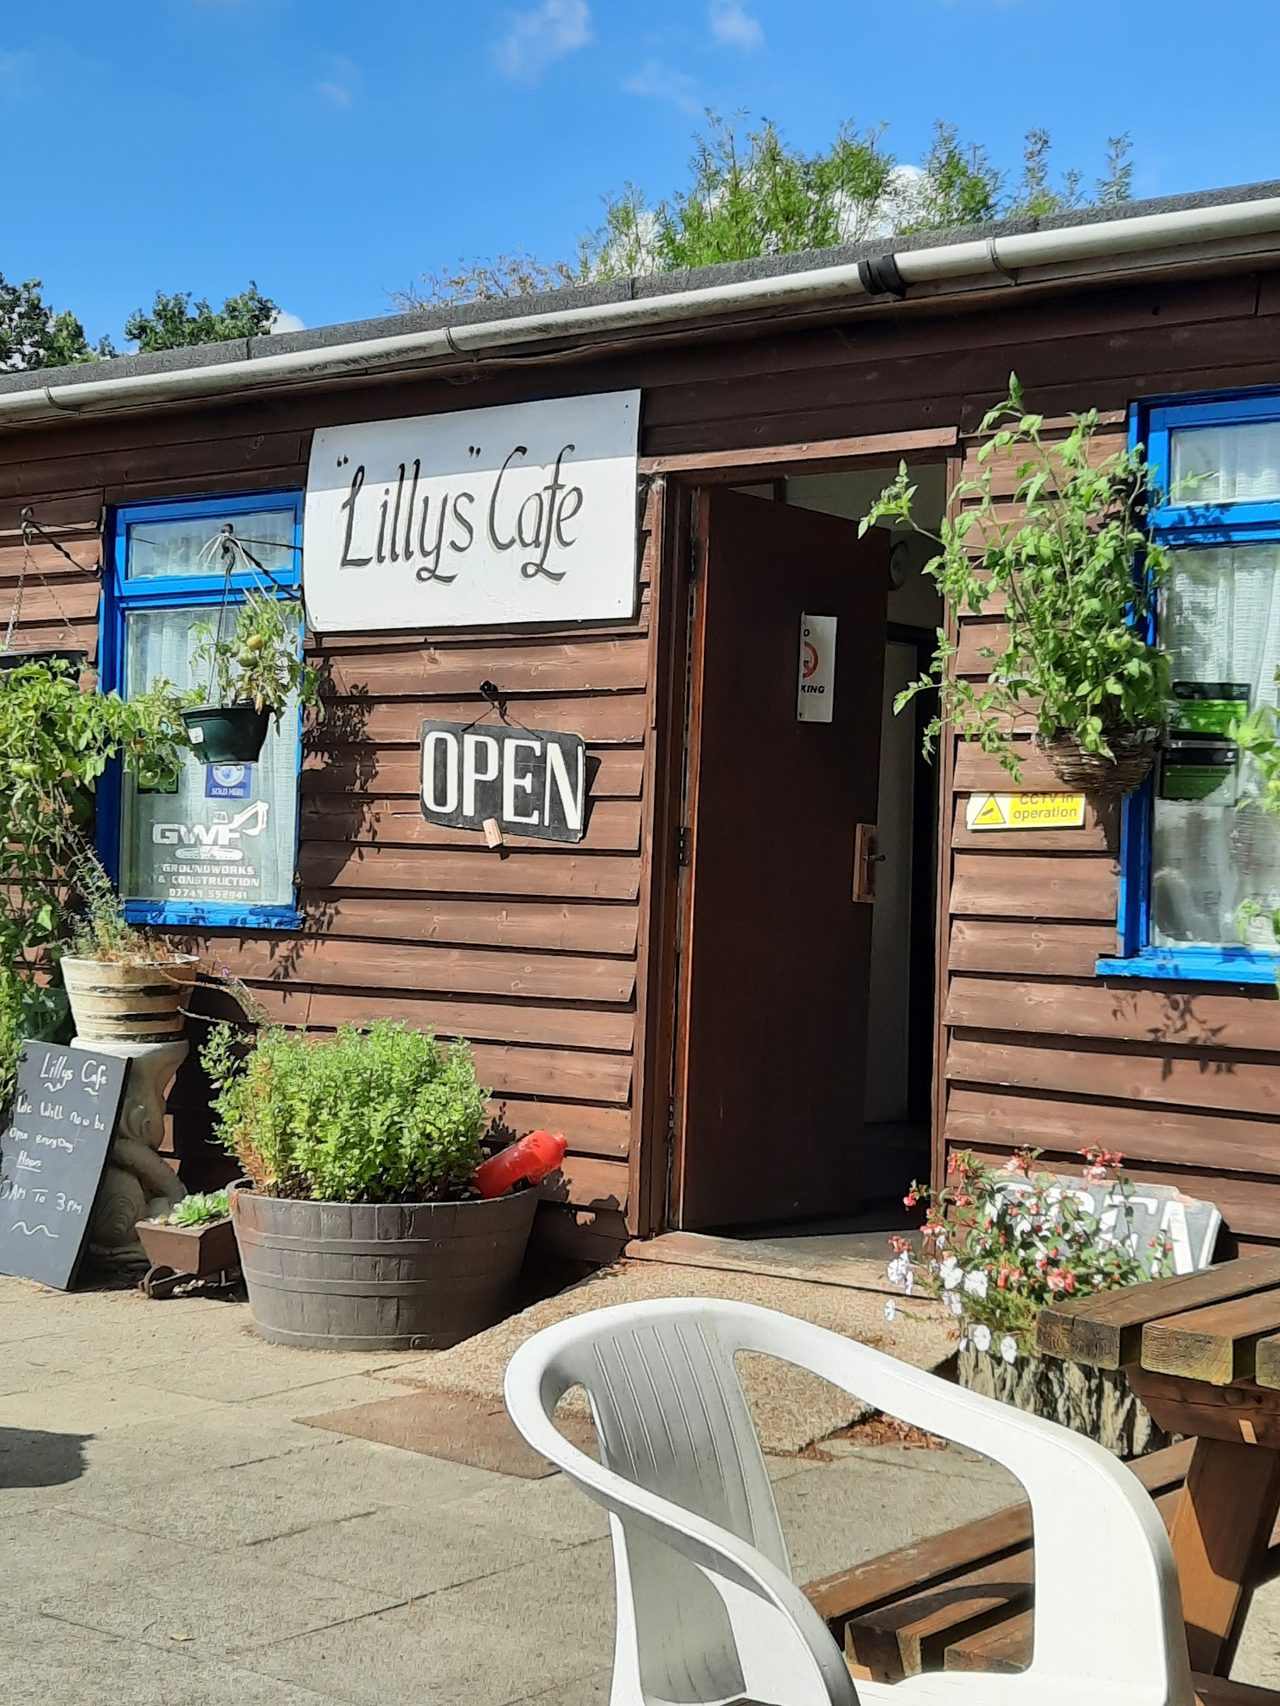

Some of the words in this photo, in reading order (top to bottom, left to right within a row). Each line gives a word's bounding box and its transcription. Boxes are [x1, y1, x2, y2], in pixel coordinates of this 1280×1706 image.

[489, 444, 584, 582] Cafe
[423, 731, 583, 830] OPEN
[1019, 793, 1057, 805] CCTV
[1061, 793, 1074, 804] in
[1013, 806, 1077, 821] operation
[162, 863, 255, 875] GROUNDWORKS
[172, 876, 260, 887] CONSTRUCTION
[40, 1053, 74, 1087] Lillys
[81, 1060, 107, 1091] Cafe
